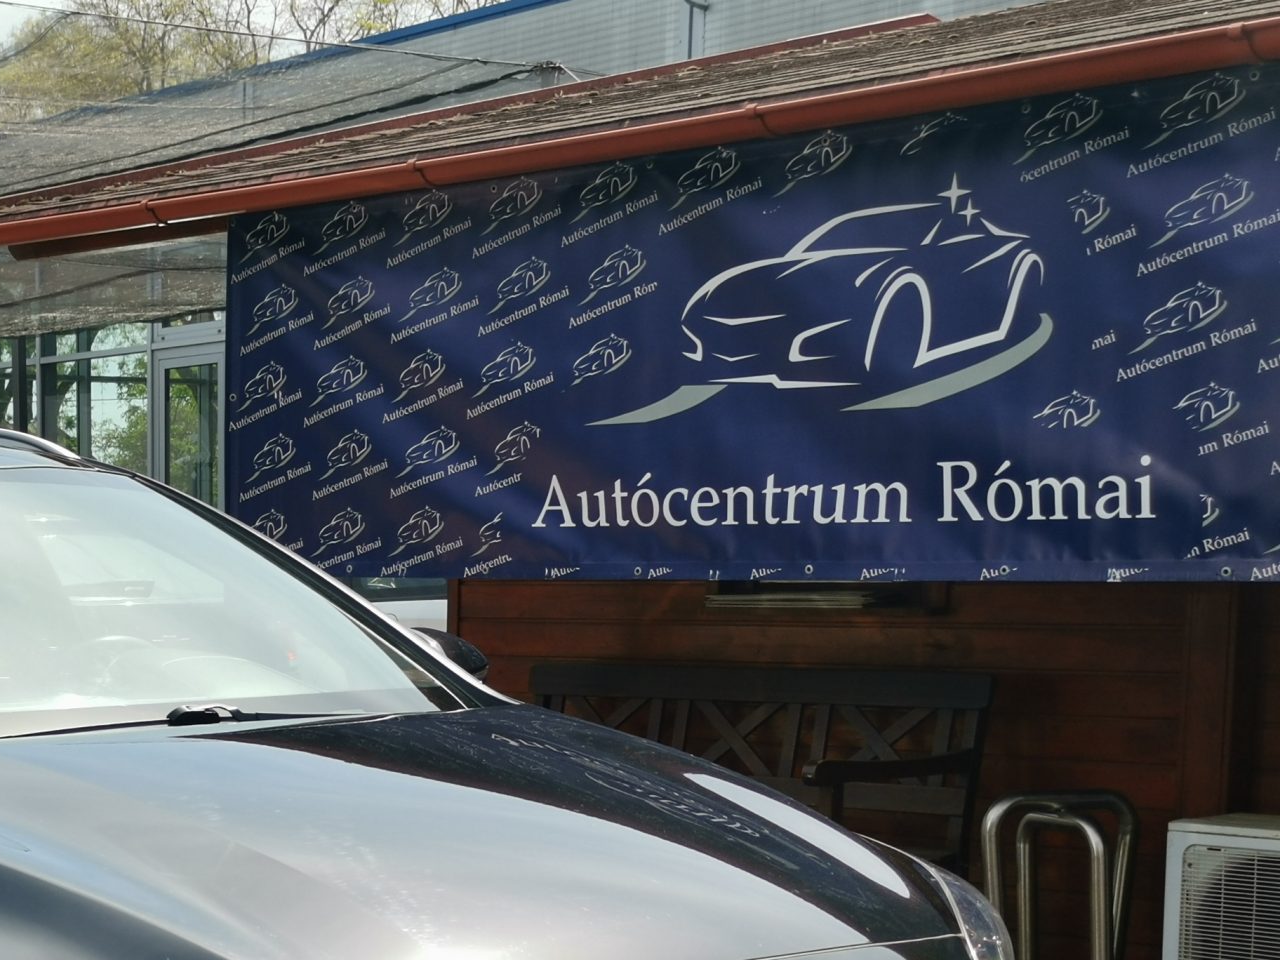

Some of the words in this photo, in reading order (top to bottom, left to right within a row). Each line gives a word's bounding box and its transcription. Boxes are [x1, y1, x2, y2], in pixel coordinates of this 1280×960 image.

[1083, 126, 1131, 155] Római
[1126, 132, 1223, 178] Autócentrum
[1227, 106, 1276, 137] Római
[560, 211, 623, 248] Autócentrum
[625, 190, 659, 215] Római
[658, 197, 723, 236] Autócentrum
[725, 177, 763, 200] Római
[303, 246, 357, 277] Autócentrum
[358, 228, 386, 249] Római
[386, 235, 441, 269] Autócentrum
[443, 217, 472, 238] Római
[472, 223, 531, 259] Autócentrum
[532, 204, 562, 227] Római
[1093, 224, 1137, 253] Római
[1136, 230, 1229, 277] Autócentrum
[230, 254, 278, 284] Autócentrum
[278, 237, 305, 257] Római
[240, 327, 286, 356] Autócentrum
[288, 311, 314, 331] Római
[313, 320, 362, 350] Autócentrum
[363, 304, 391, 324] Római
[390, 313, 448, 345] Autócentrum
[450, 295, 479, 317] Római
[478, 304, 537, 337] Autócentrum
[539, 286, 569, 308] Római
[568, 292, 632, 329] Autócentrum
[1116, 340, 1206, 382] Autócentrum
[1210, 318, 1257, 347] Római
[228, 404, 277, 432] Autócentrum
[279, 389, 302, 407] Római
[303, 399, 353, 428] Autócentrum
[355, 384, 384, 404] Római
[382, 394, 437, 424] Autócentrum
[438, 378, 464, 397] Római
[466, 389, 522, 420] Autócentrum
[524, 372, 554, 393] Római
[1222, 421, 1270, 448] Római
[239, 476, 285, 502] Autócentrum
[287, 462, 311, 479] Római
[312, 469, 362, 501] Autócentrum
[363, 459, 388, 477] Római
[390, 470, 445, 499] Autócentrum
[447, 456, 478, 476] Római
[531, 473, 912, 528] Autócentrum
[936, 455, 1157, 523] Római
[356, 537, 381, 555] Római
[380, 551, 434, 577] Autócentrum
[436, 537, 463, 555] Római
[1203, 527, 1250, 553] Római
